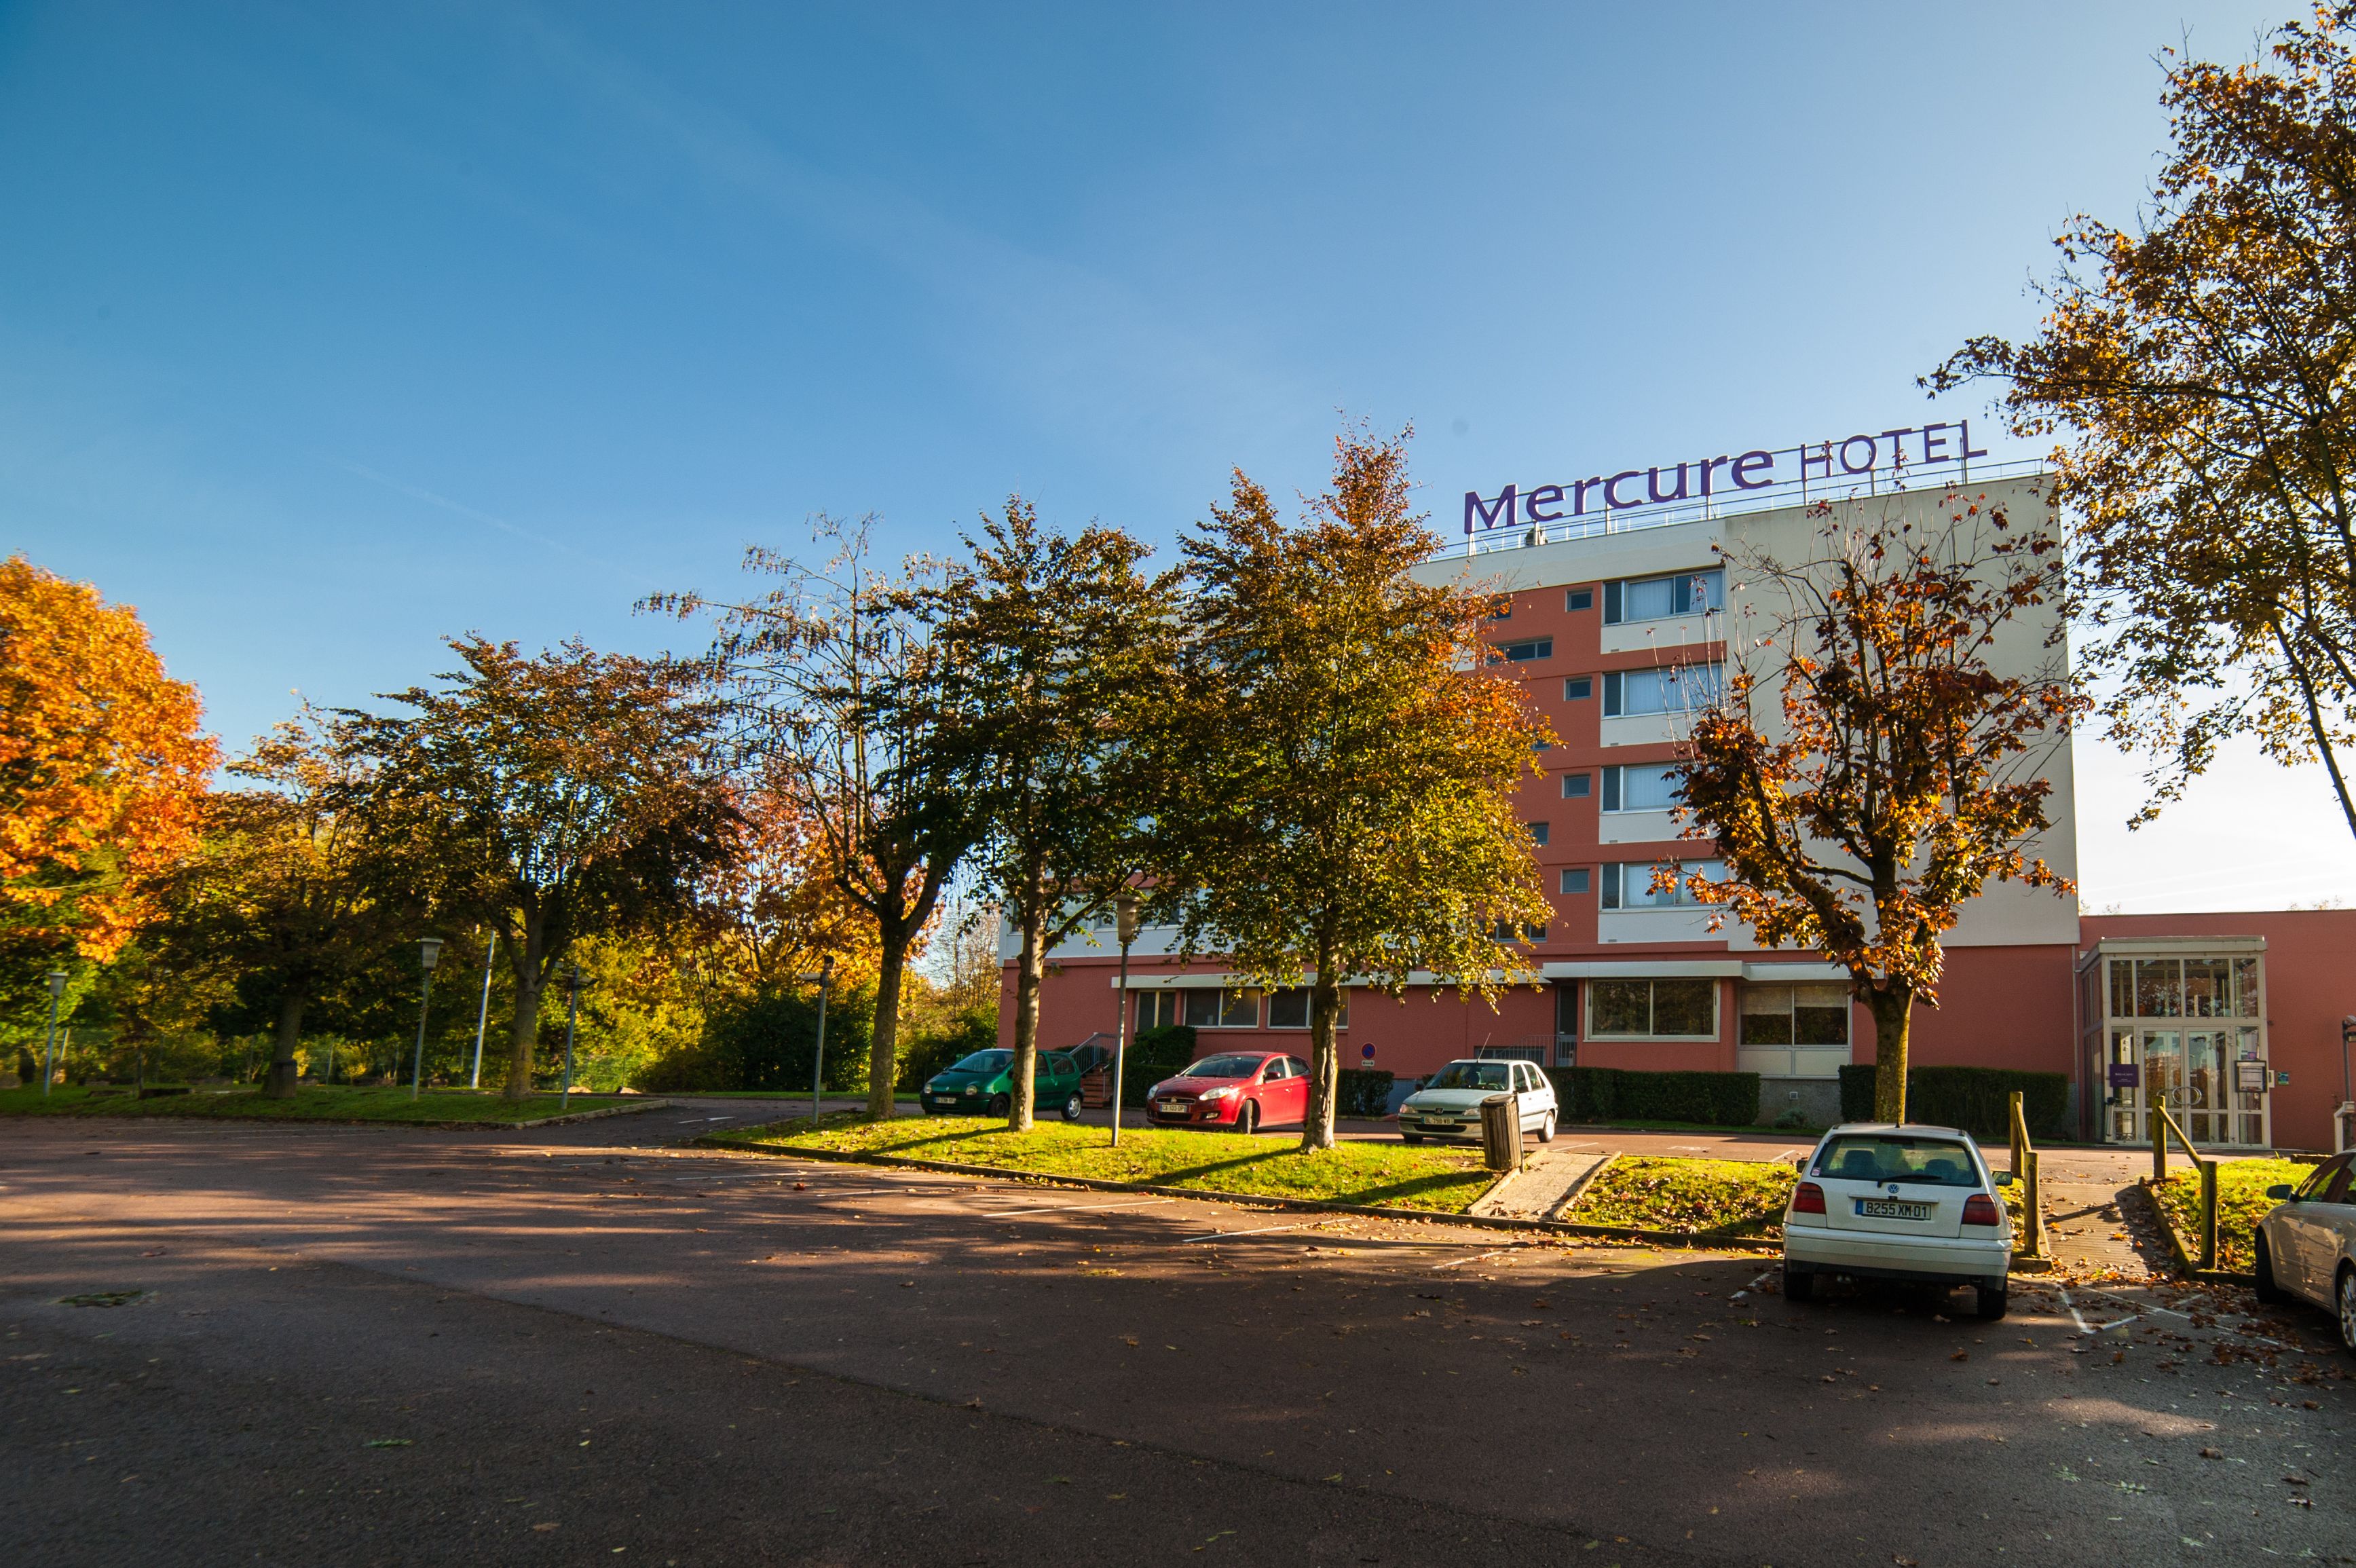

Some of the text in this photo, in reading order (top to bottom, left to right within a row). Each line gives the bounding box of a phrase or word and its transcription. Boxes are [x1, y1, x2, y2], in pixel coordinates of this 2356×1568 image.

[1464, 419, 1988, 534] Mercure HOTEL
[1866, 1202, 1896, 1215] 8255
[1913, 1206, 1927, 1218] 01
